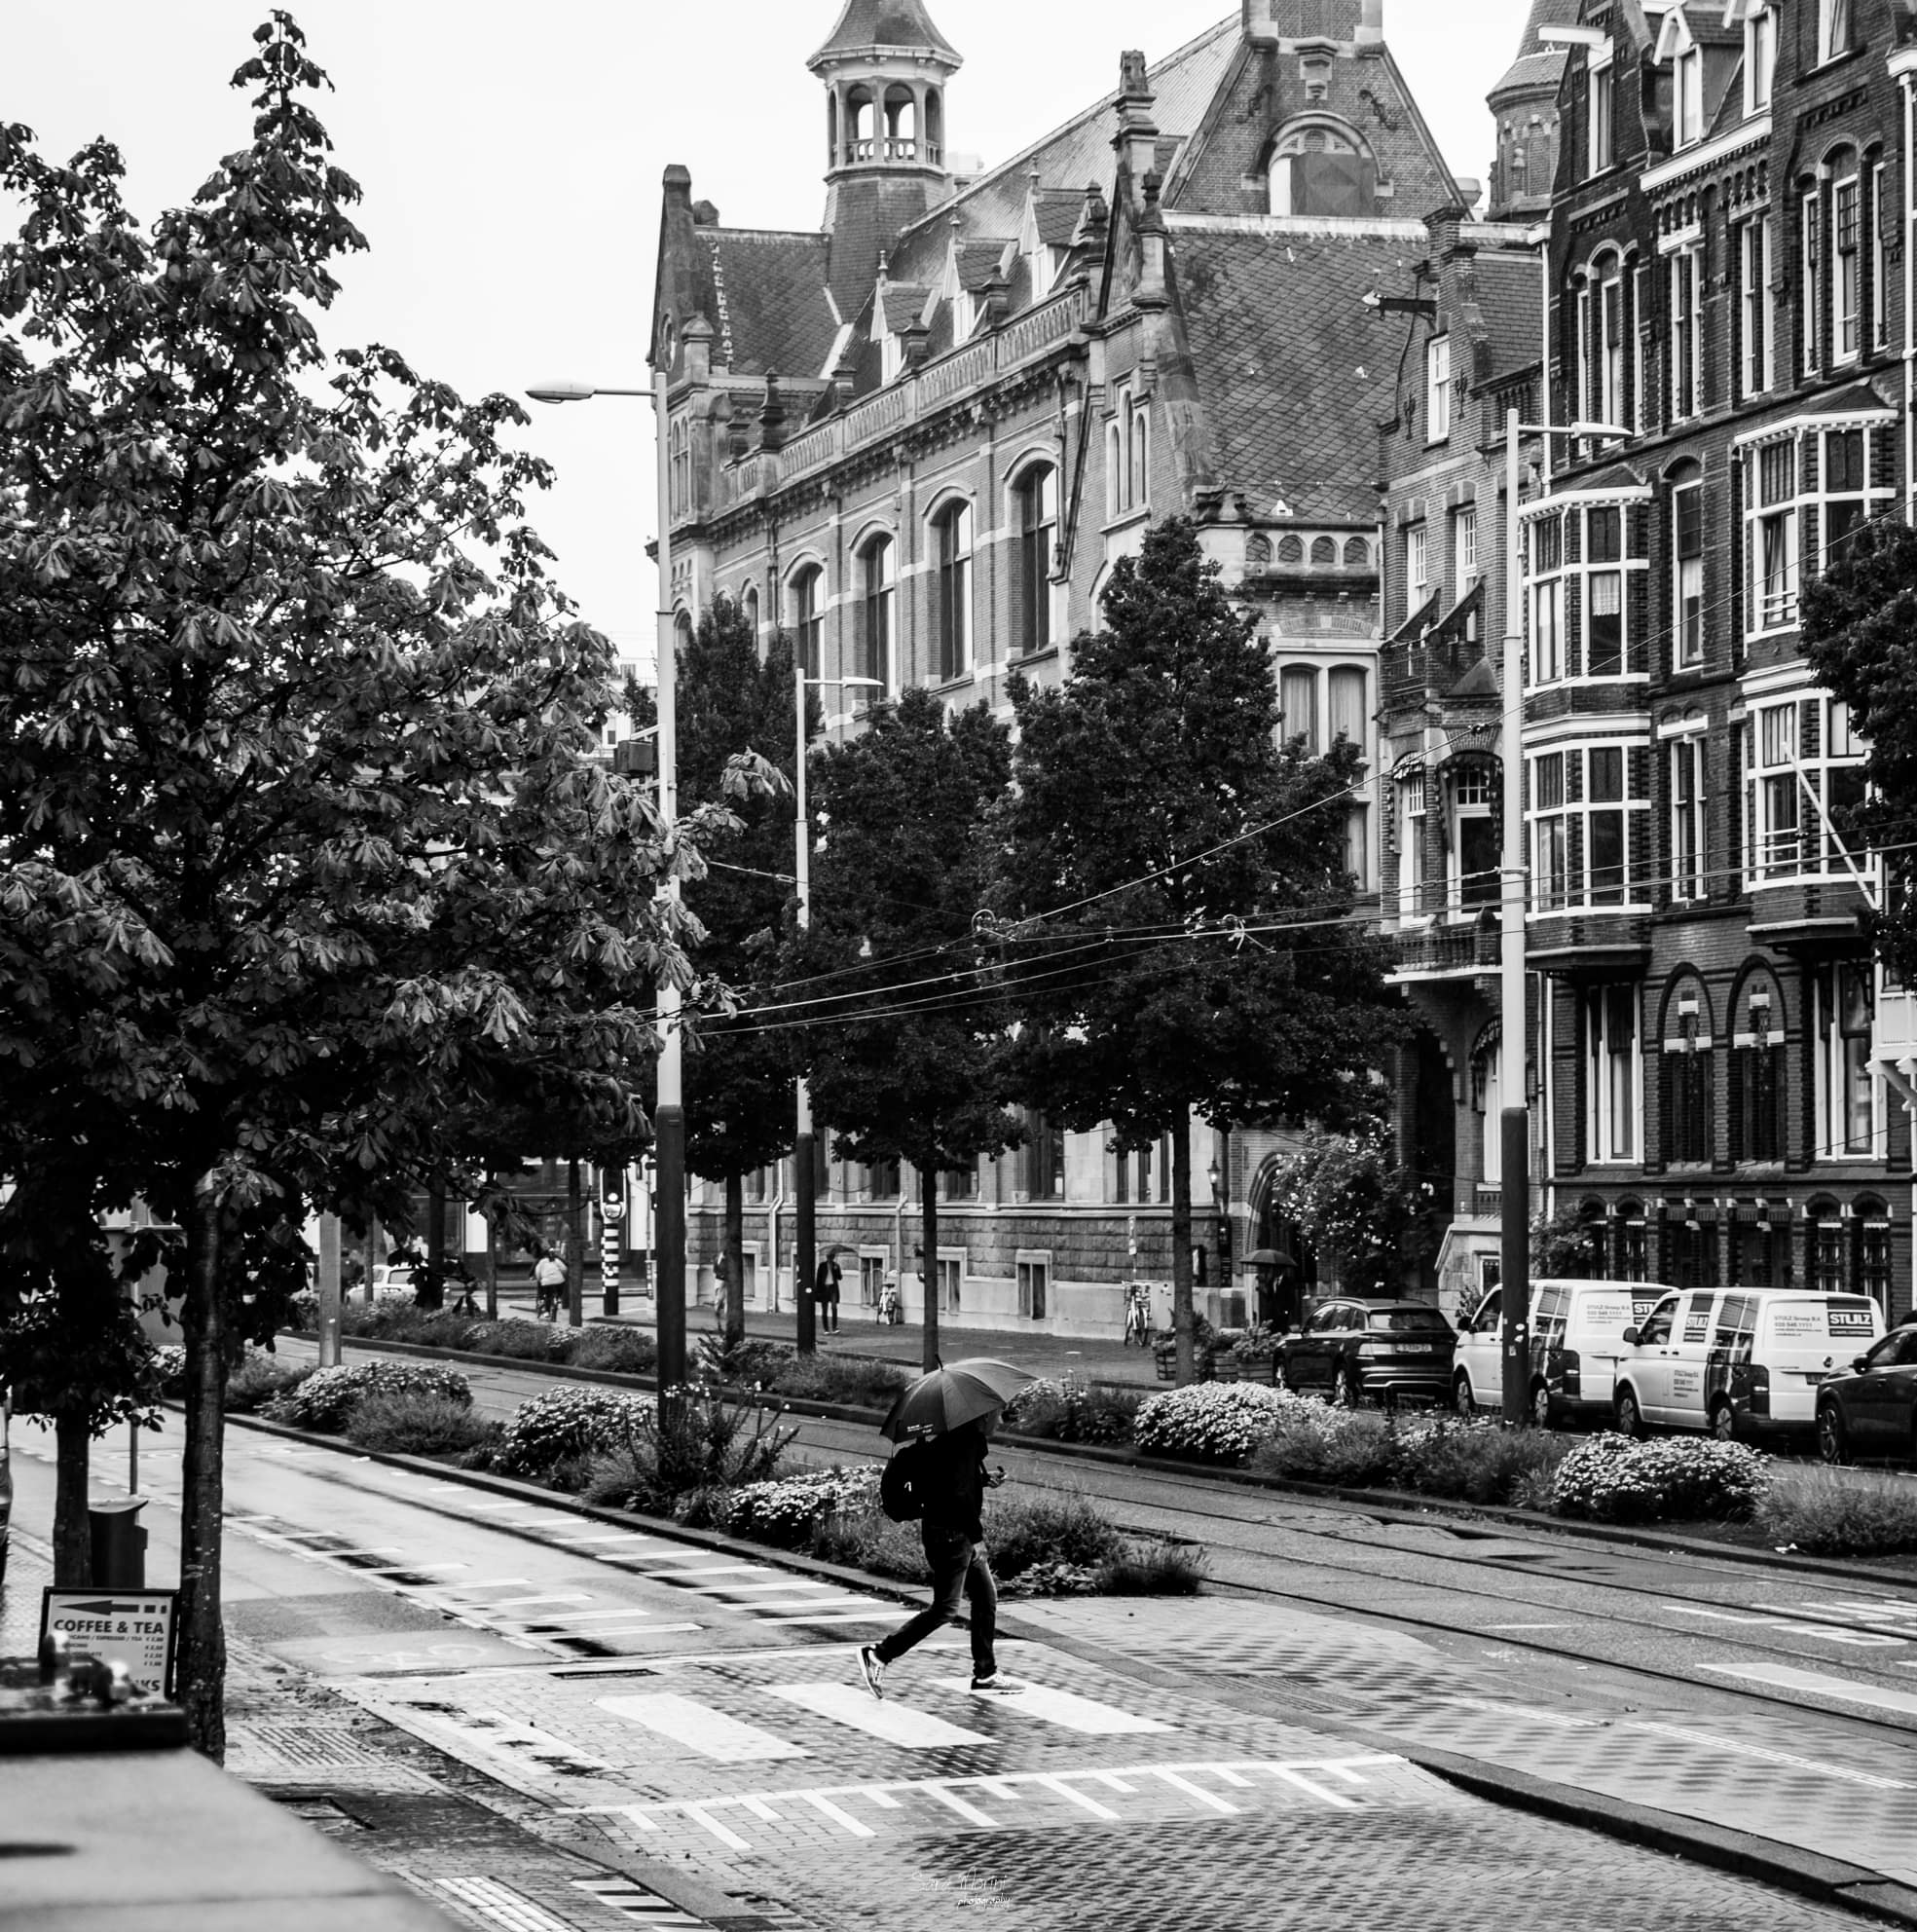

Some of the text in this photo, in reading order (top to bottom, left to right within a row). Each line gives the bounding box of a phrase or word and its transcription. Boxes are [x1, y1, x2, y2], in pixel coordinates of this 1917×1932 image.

[1829, 1314, 1871, 1325] STULZ
[54, 1619, 164, 1634] COFFEE & TEA
